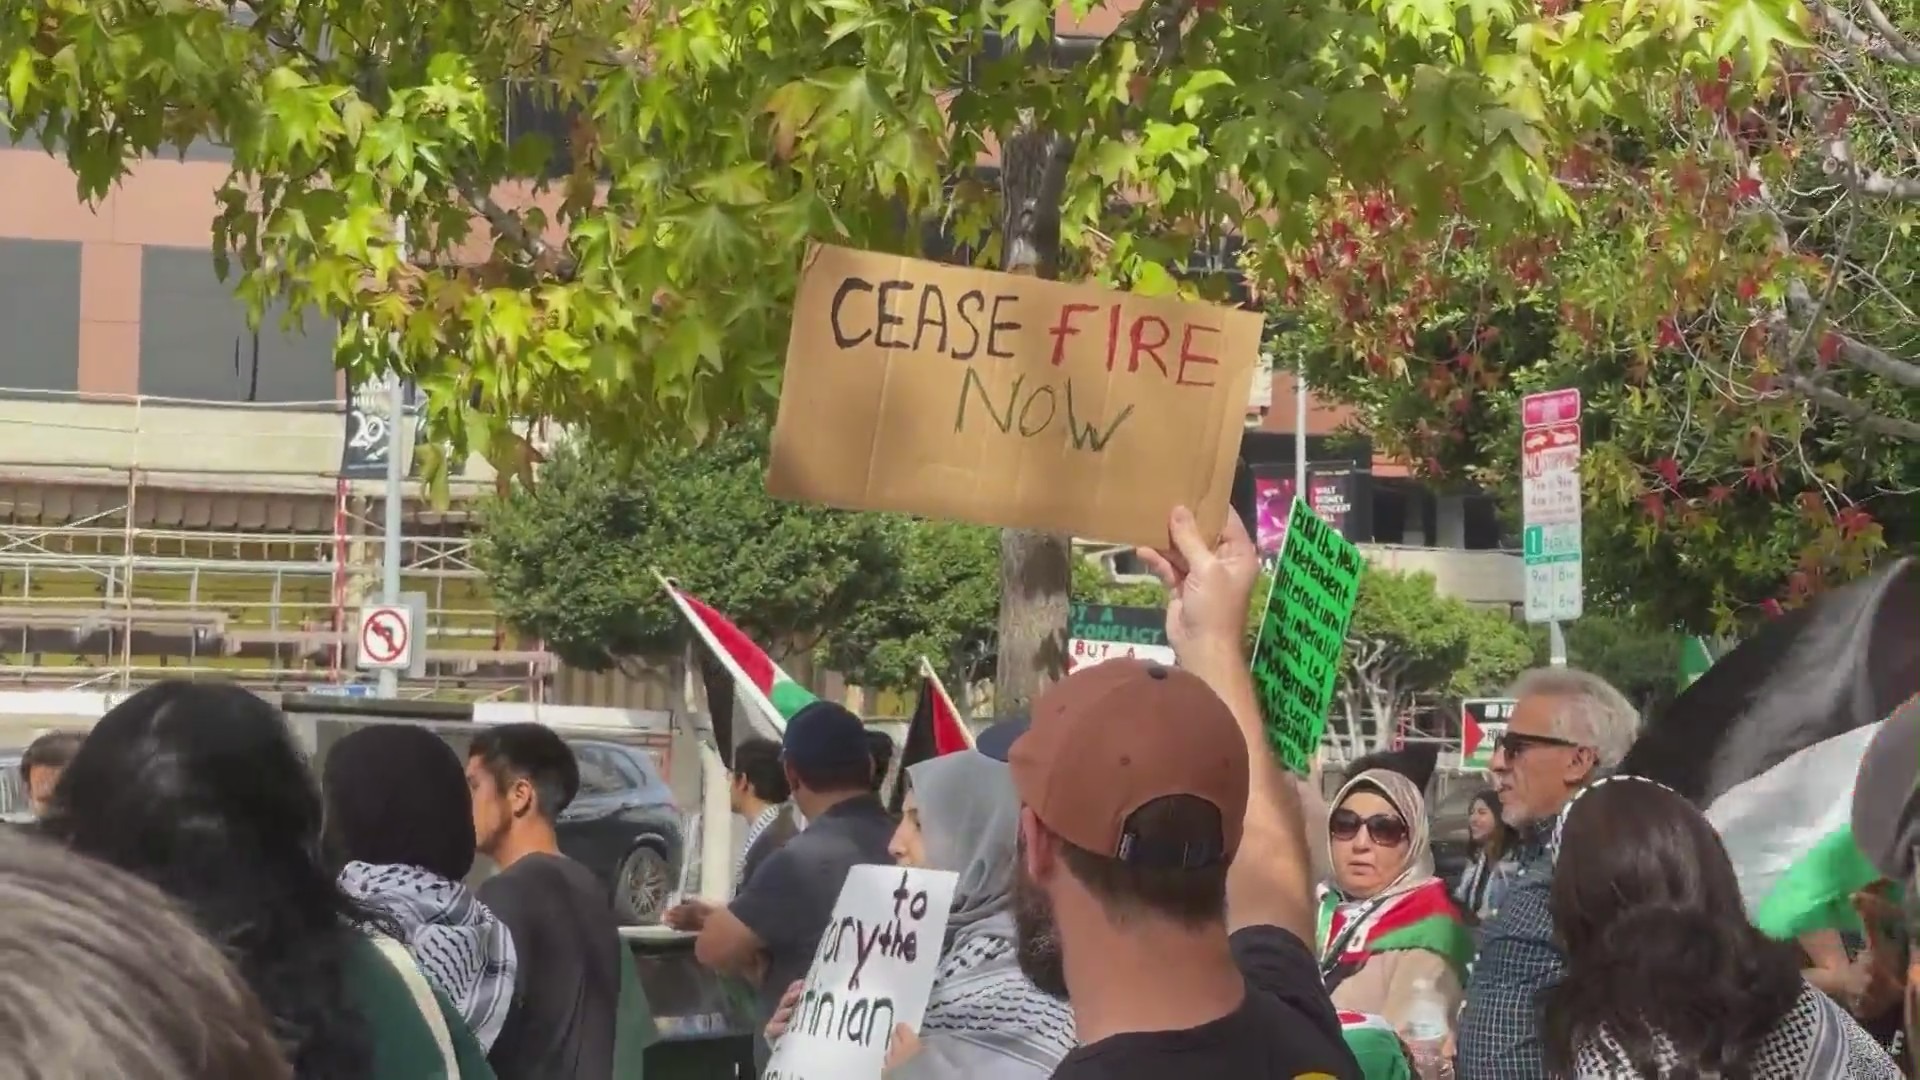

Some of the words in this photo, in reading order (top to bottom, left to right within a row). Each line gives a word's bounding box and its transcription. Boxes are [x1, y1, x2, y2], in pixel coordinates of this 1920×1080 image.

[831, 277, 1022, 361] CEASE
[1049, 303, 1221, 387] FIRE
[954, 366, 1134, 453] NOW
[1072, 622, 1163, 645] CONFLICT
[1101, 606, 1114, 622] A
[1075, 640, 1110, 659] BUT
[1127, 645, 1136, 660] A
[893, 869, 928, 921] to
[878, 917, 918, 964] the
